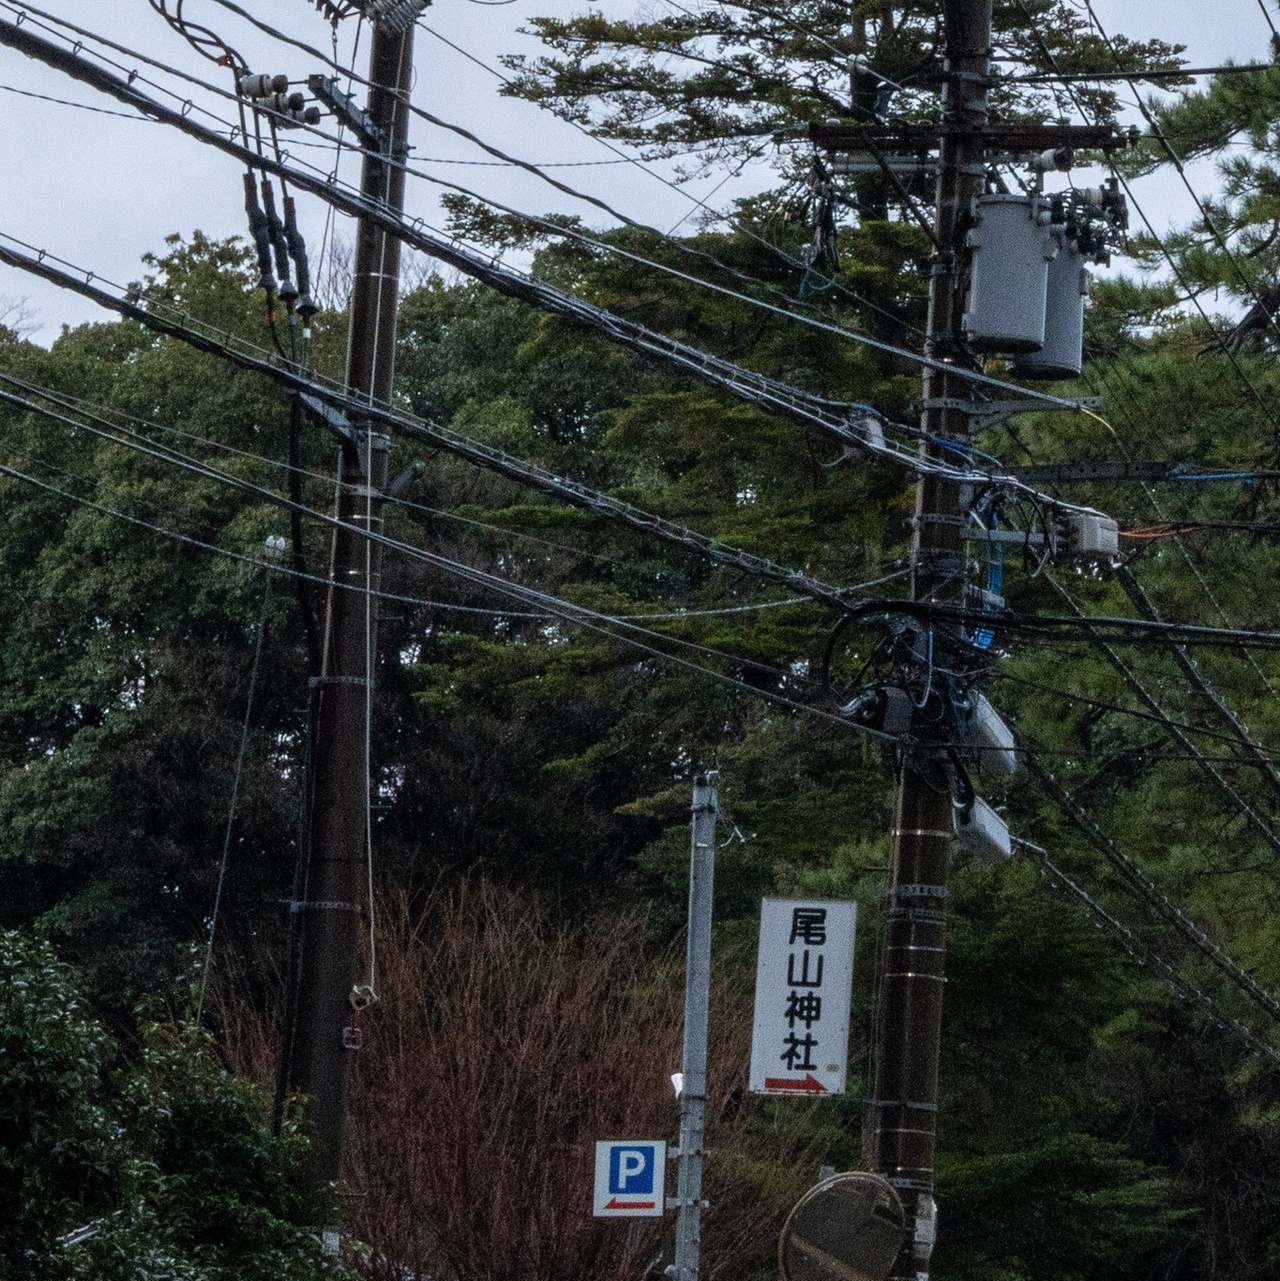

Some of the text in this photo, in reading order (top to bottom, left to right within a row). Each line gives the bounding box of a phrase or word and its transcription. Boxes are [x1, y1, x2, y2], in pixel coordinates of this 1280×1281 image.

[779, 907, 827, 1070] 尾山神社
[618, 1150, 645, 1189] P
